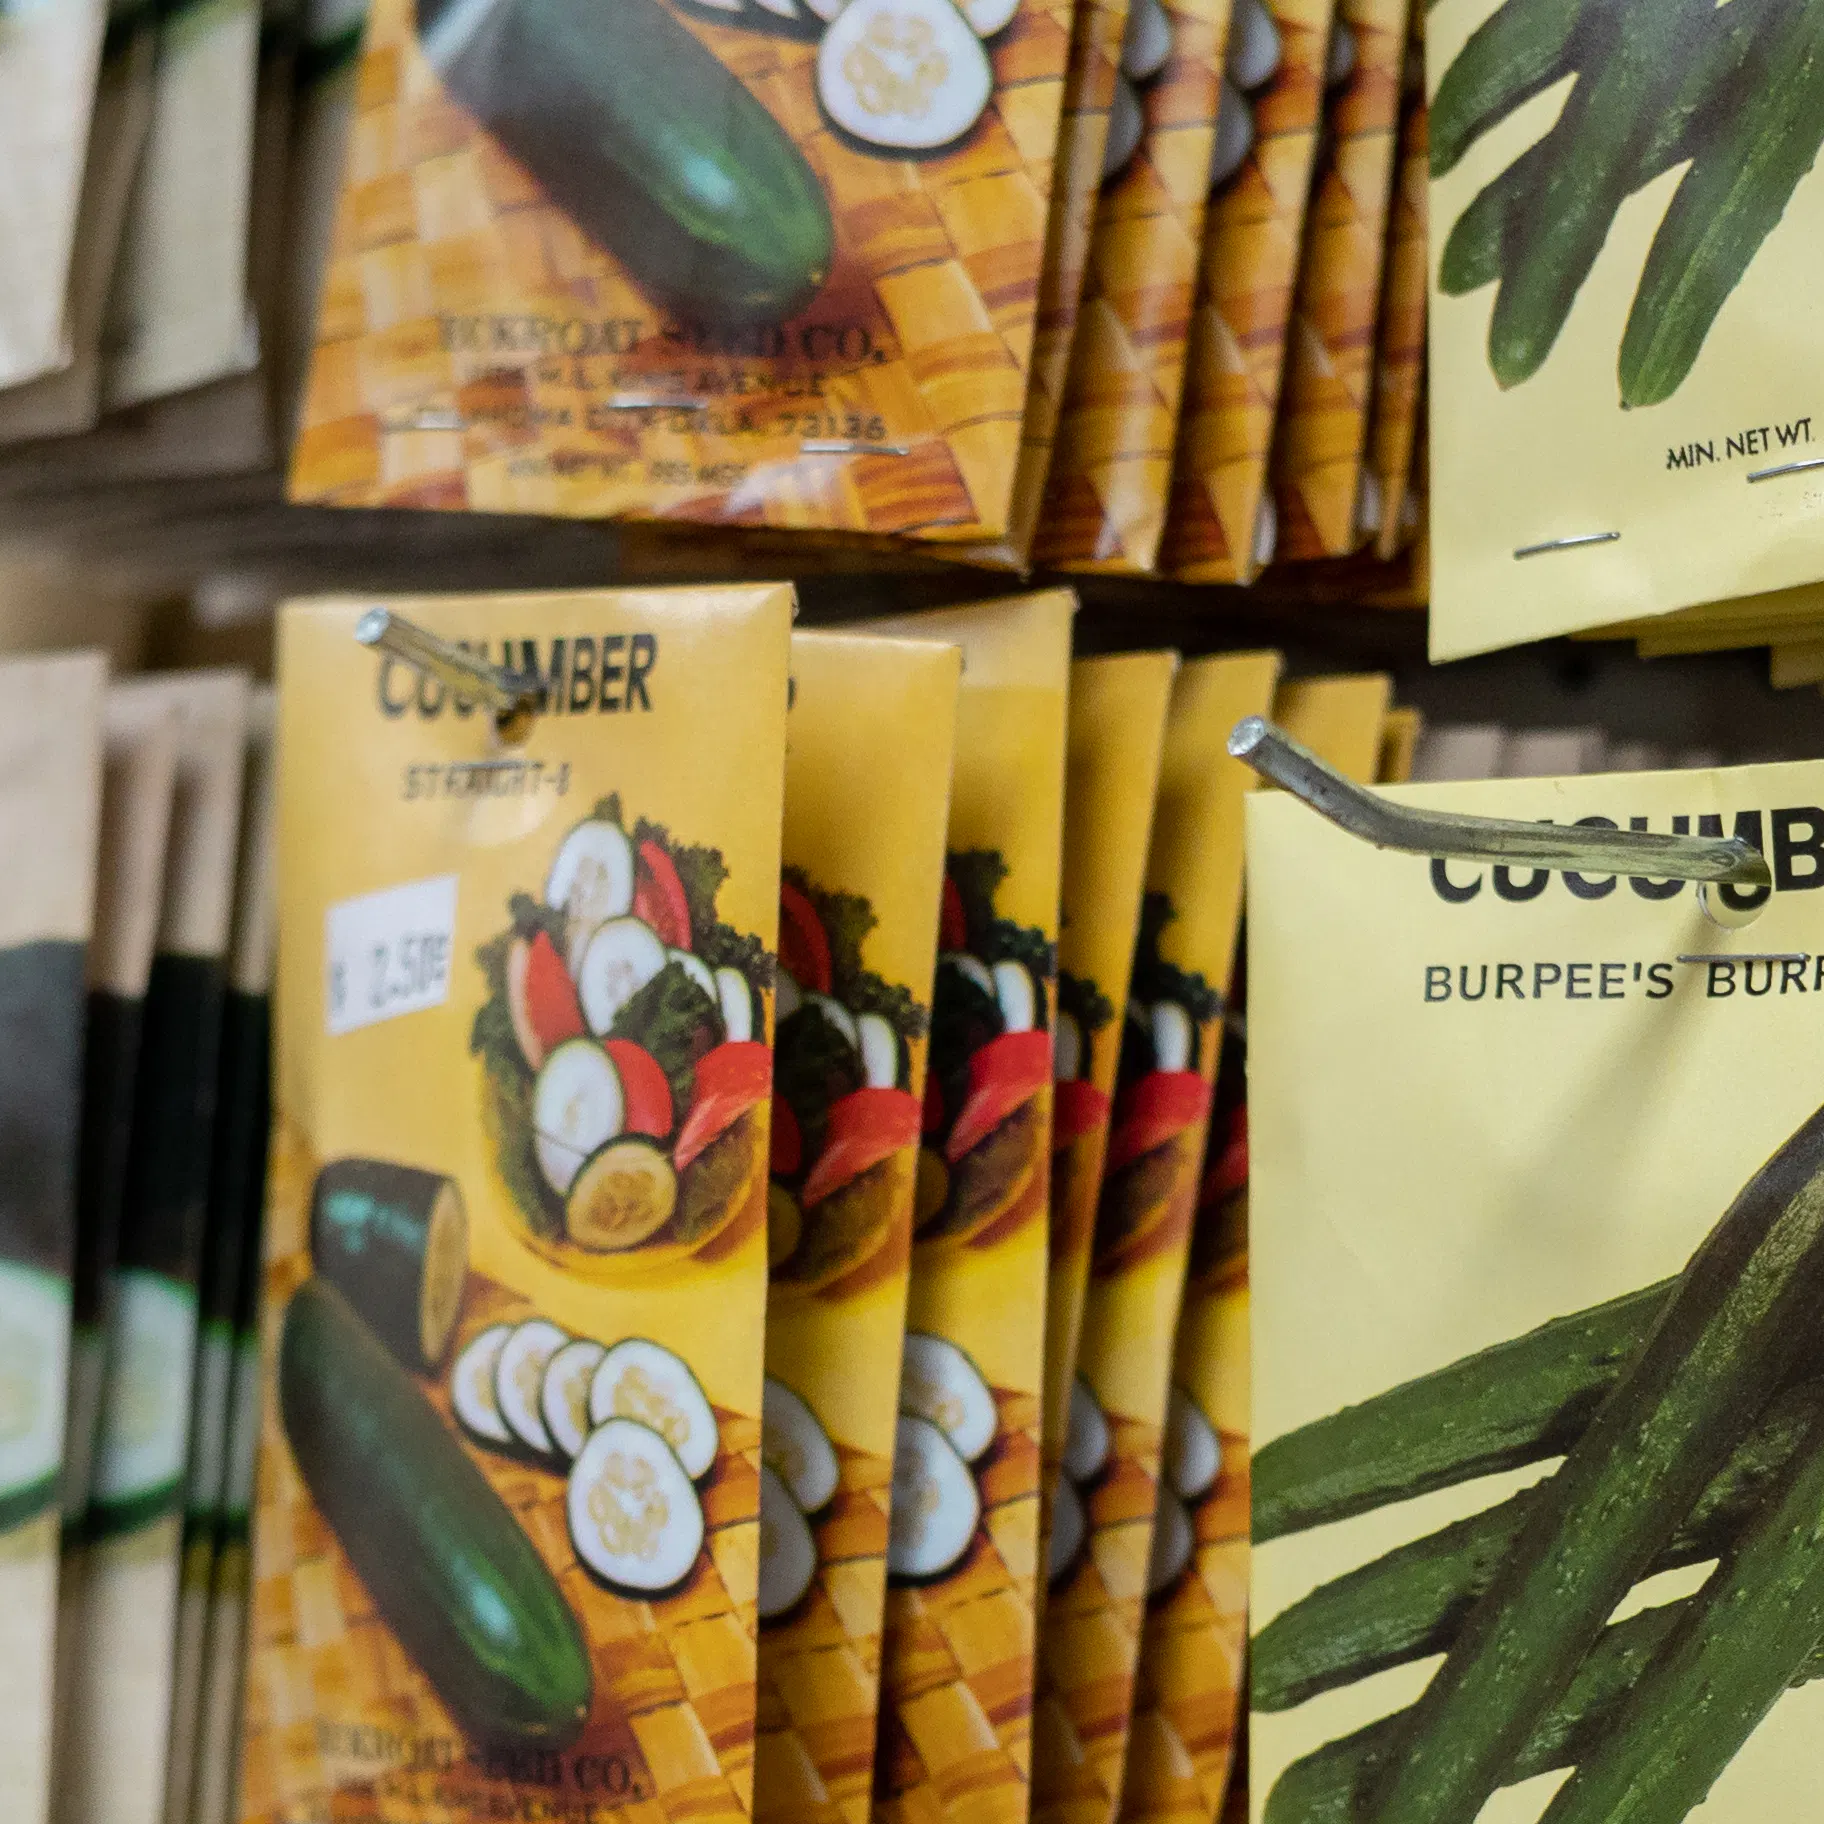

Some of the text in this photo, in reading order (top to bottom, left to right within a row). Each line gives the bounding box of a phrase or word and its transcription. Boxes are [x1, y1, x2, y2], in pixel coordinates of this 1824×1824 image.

[1665, 441, 1722, 471] MIN.
[1724, 425, 1770, 464] NET
[1776, 417, 1816, 448] WT.
[1424, 961, 1675, 1003] BURPEE'S
